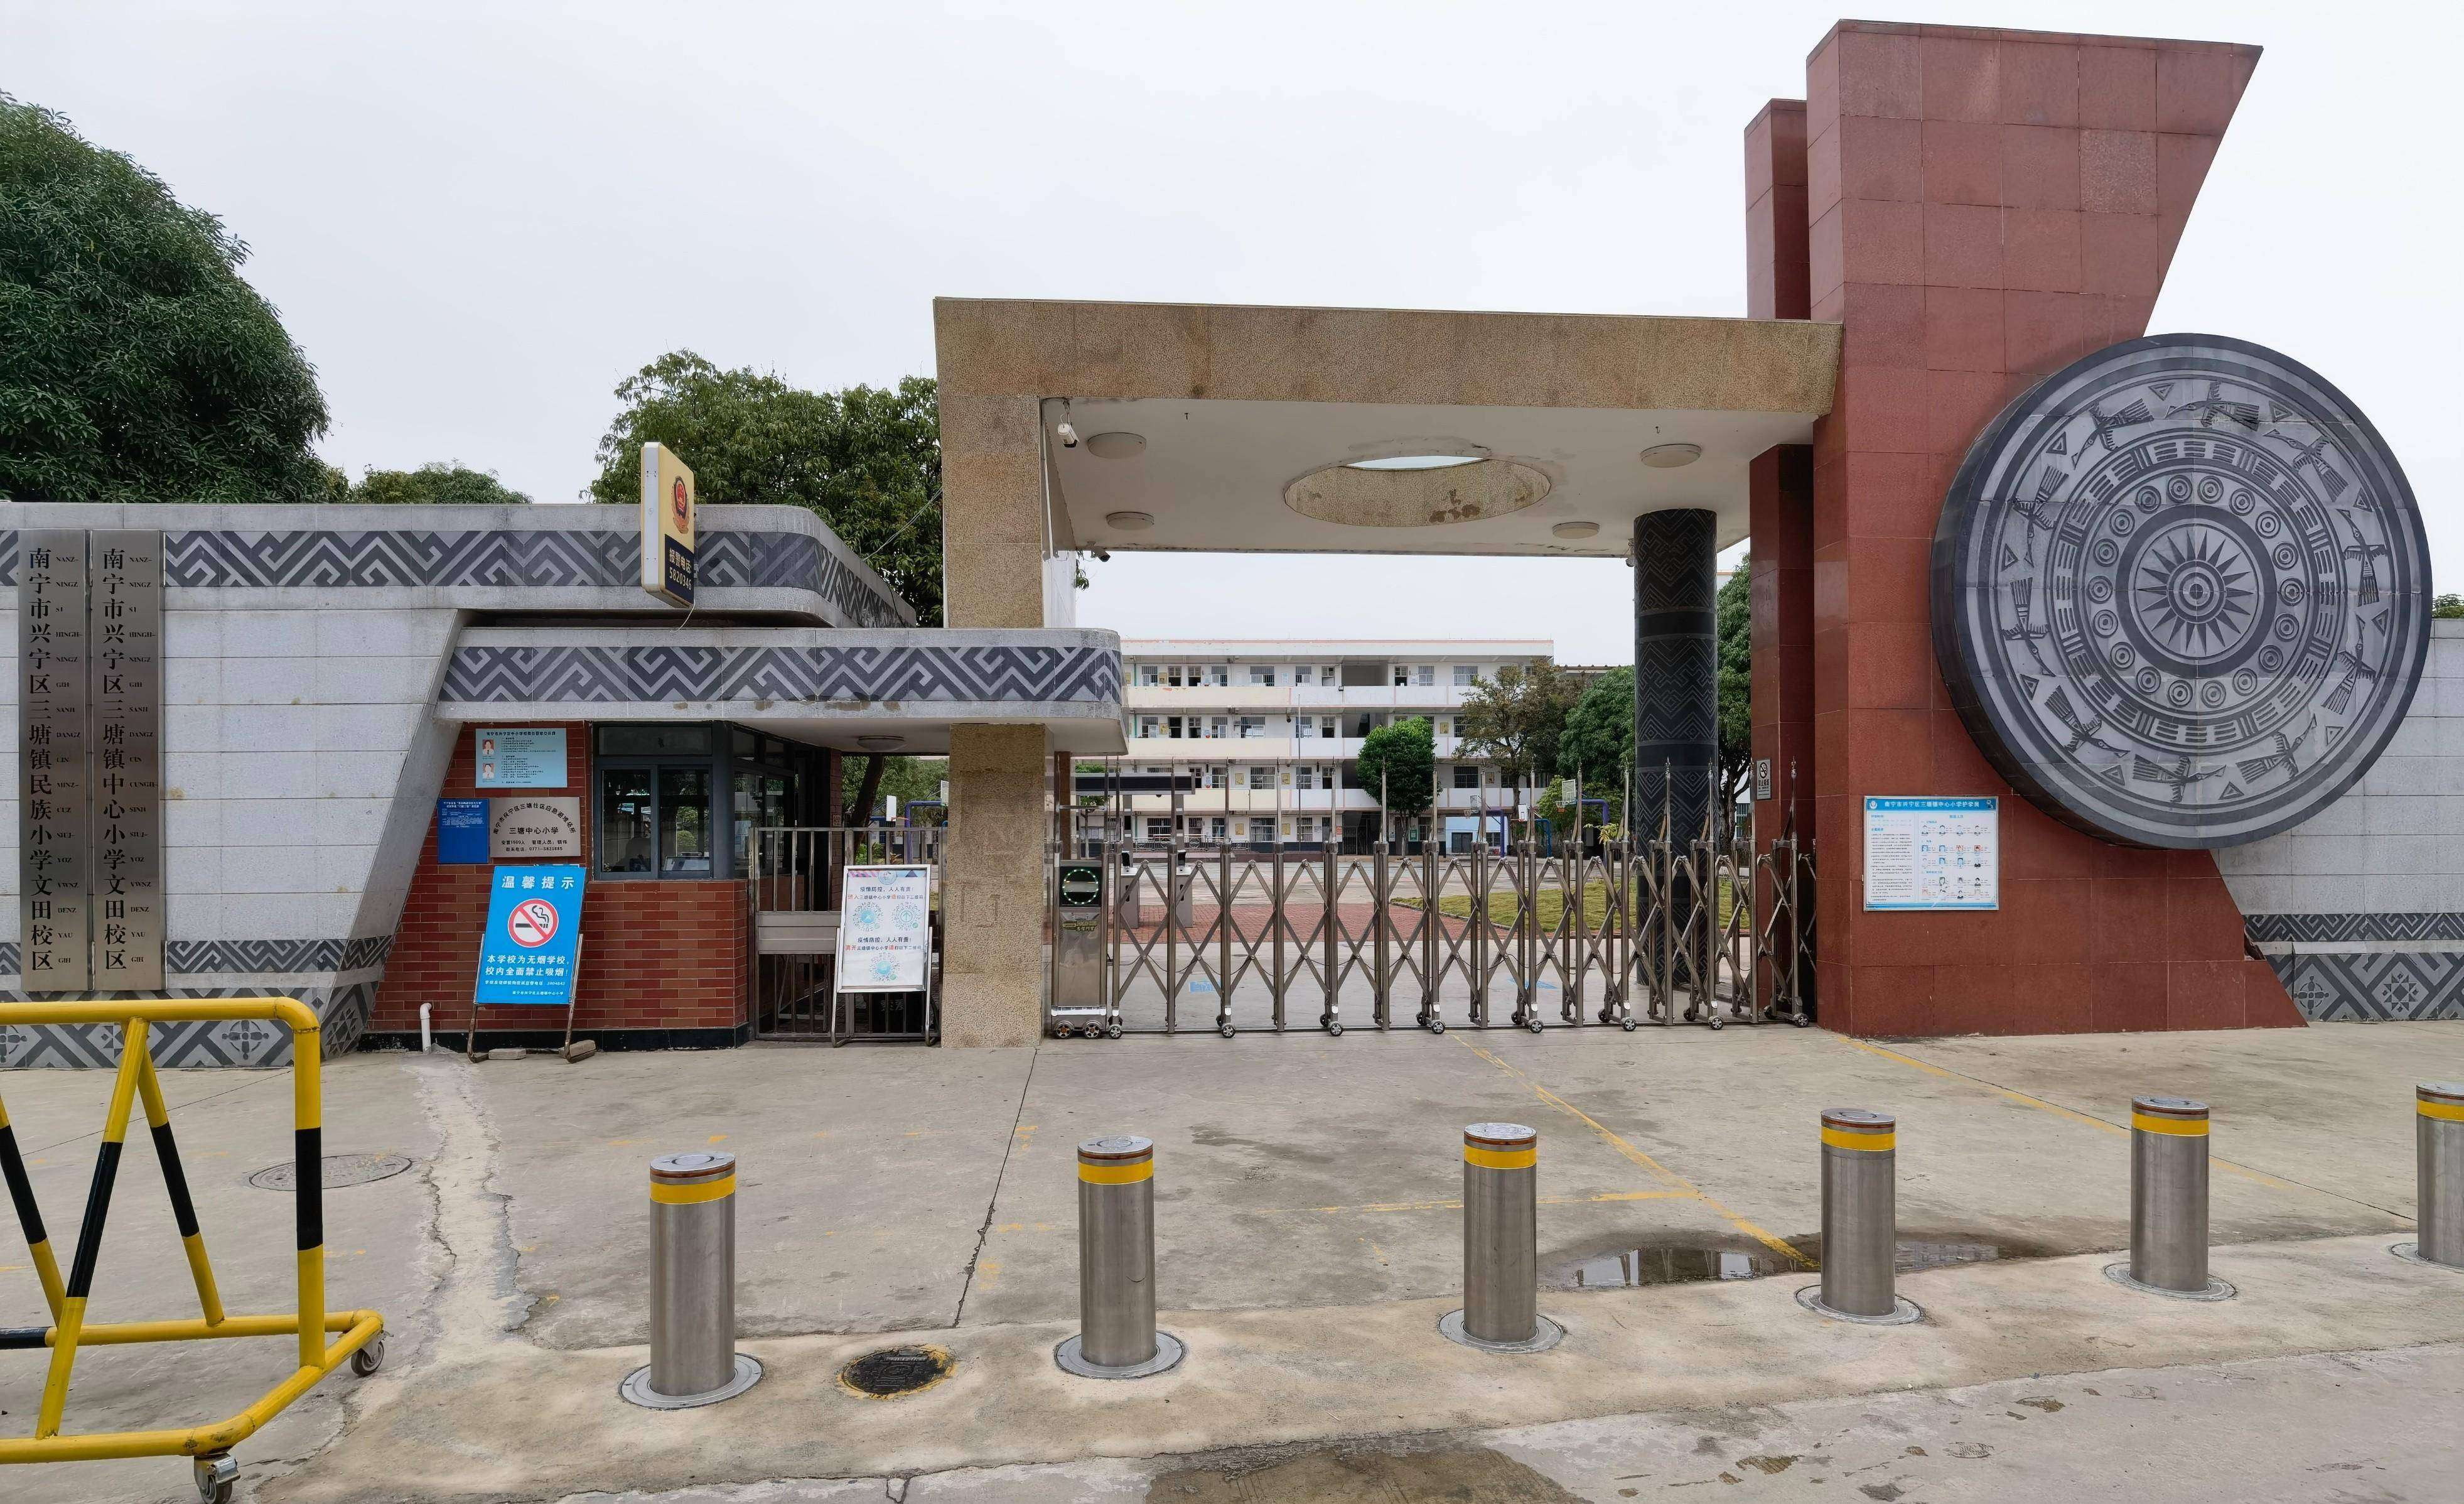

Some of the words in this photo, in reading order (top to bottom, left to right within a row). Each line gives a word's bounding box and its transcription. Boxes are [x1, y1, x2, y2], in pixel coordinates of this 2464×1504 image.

[669, 567, 691, 590] 5820346
[29, 548, 53, 970] 南宁市兴宁区三塘镇民族小学文田校区
[102, 548, 126, 970] 南宁市兴宁区三塘镇中心小学文田校区
[501, 875, 574, 889] 温馨提示
